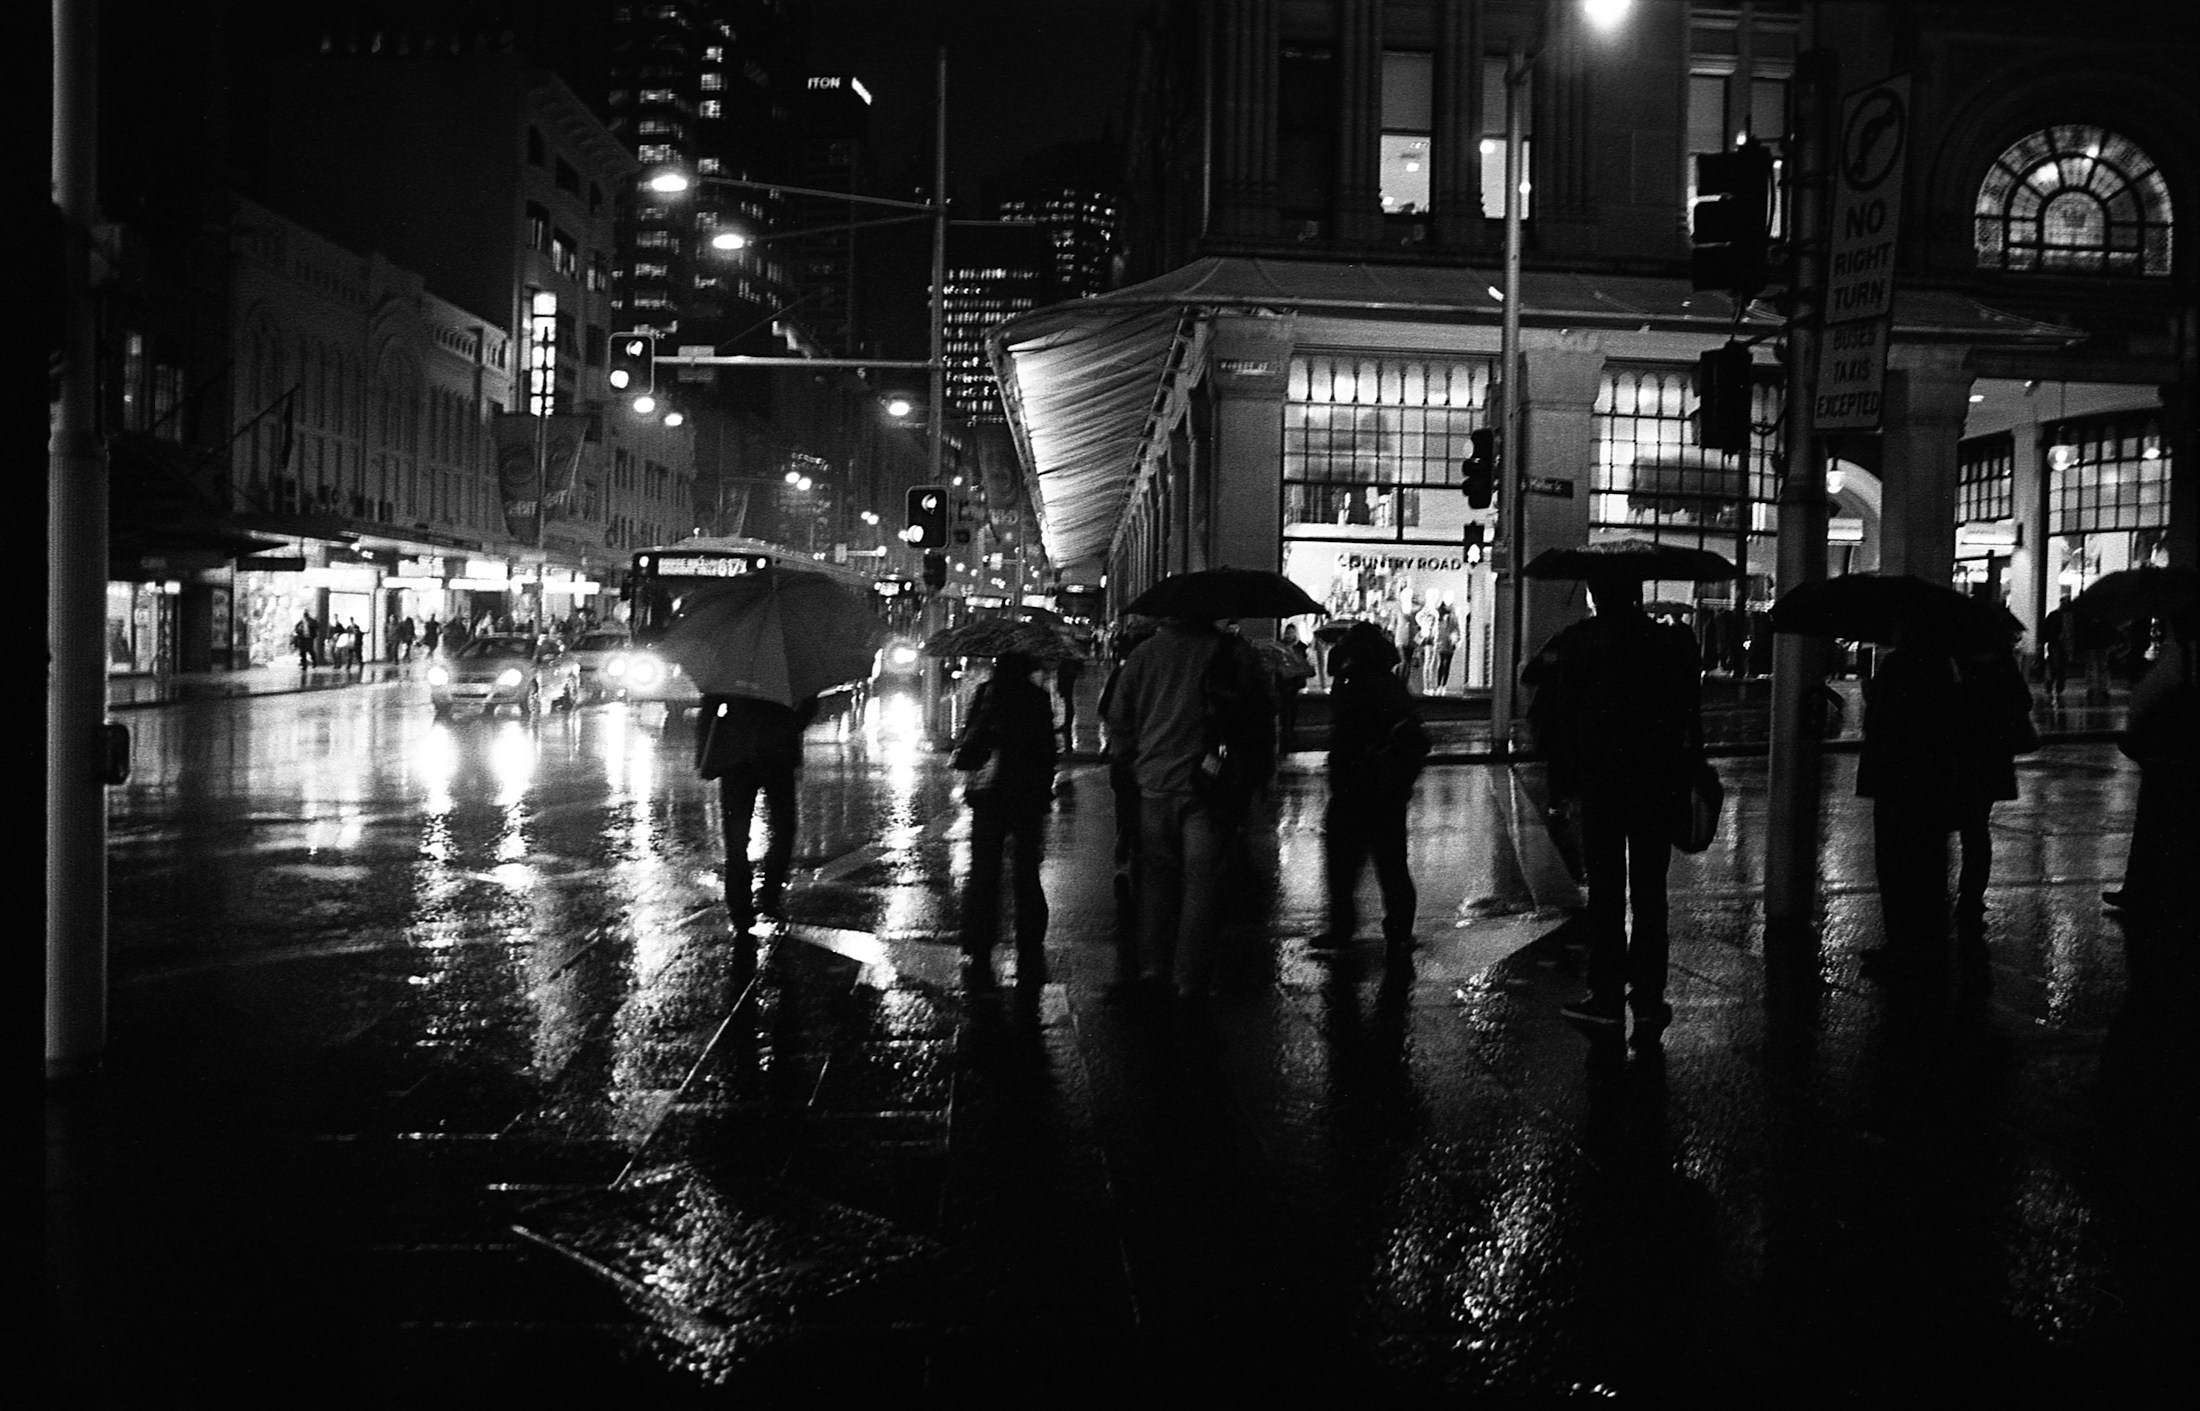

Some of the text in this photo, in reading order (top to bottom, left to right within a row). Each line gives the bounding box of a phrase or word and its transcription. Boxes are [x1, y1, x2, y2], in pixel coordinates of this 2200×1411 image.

[1845, 199, 1885, 240] NO
[1834, 241, 1891, 277] RIGHT
[1834, 279, 1885, 310] TURN
[1833, 325, 1876, 350] BUSES
[1817, 391, 1881, 417] EXCEPTED
[1338, 554, 1461, 571] COUNTRY ROAD
